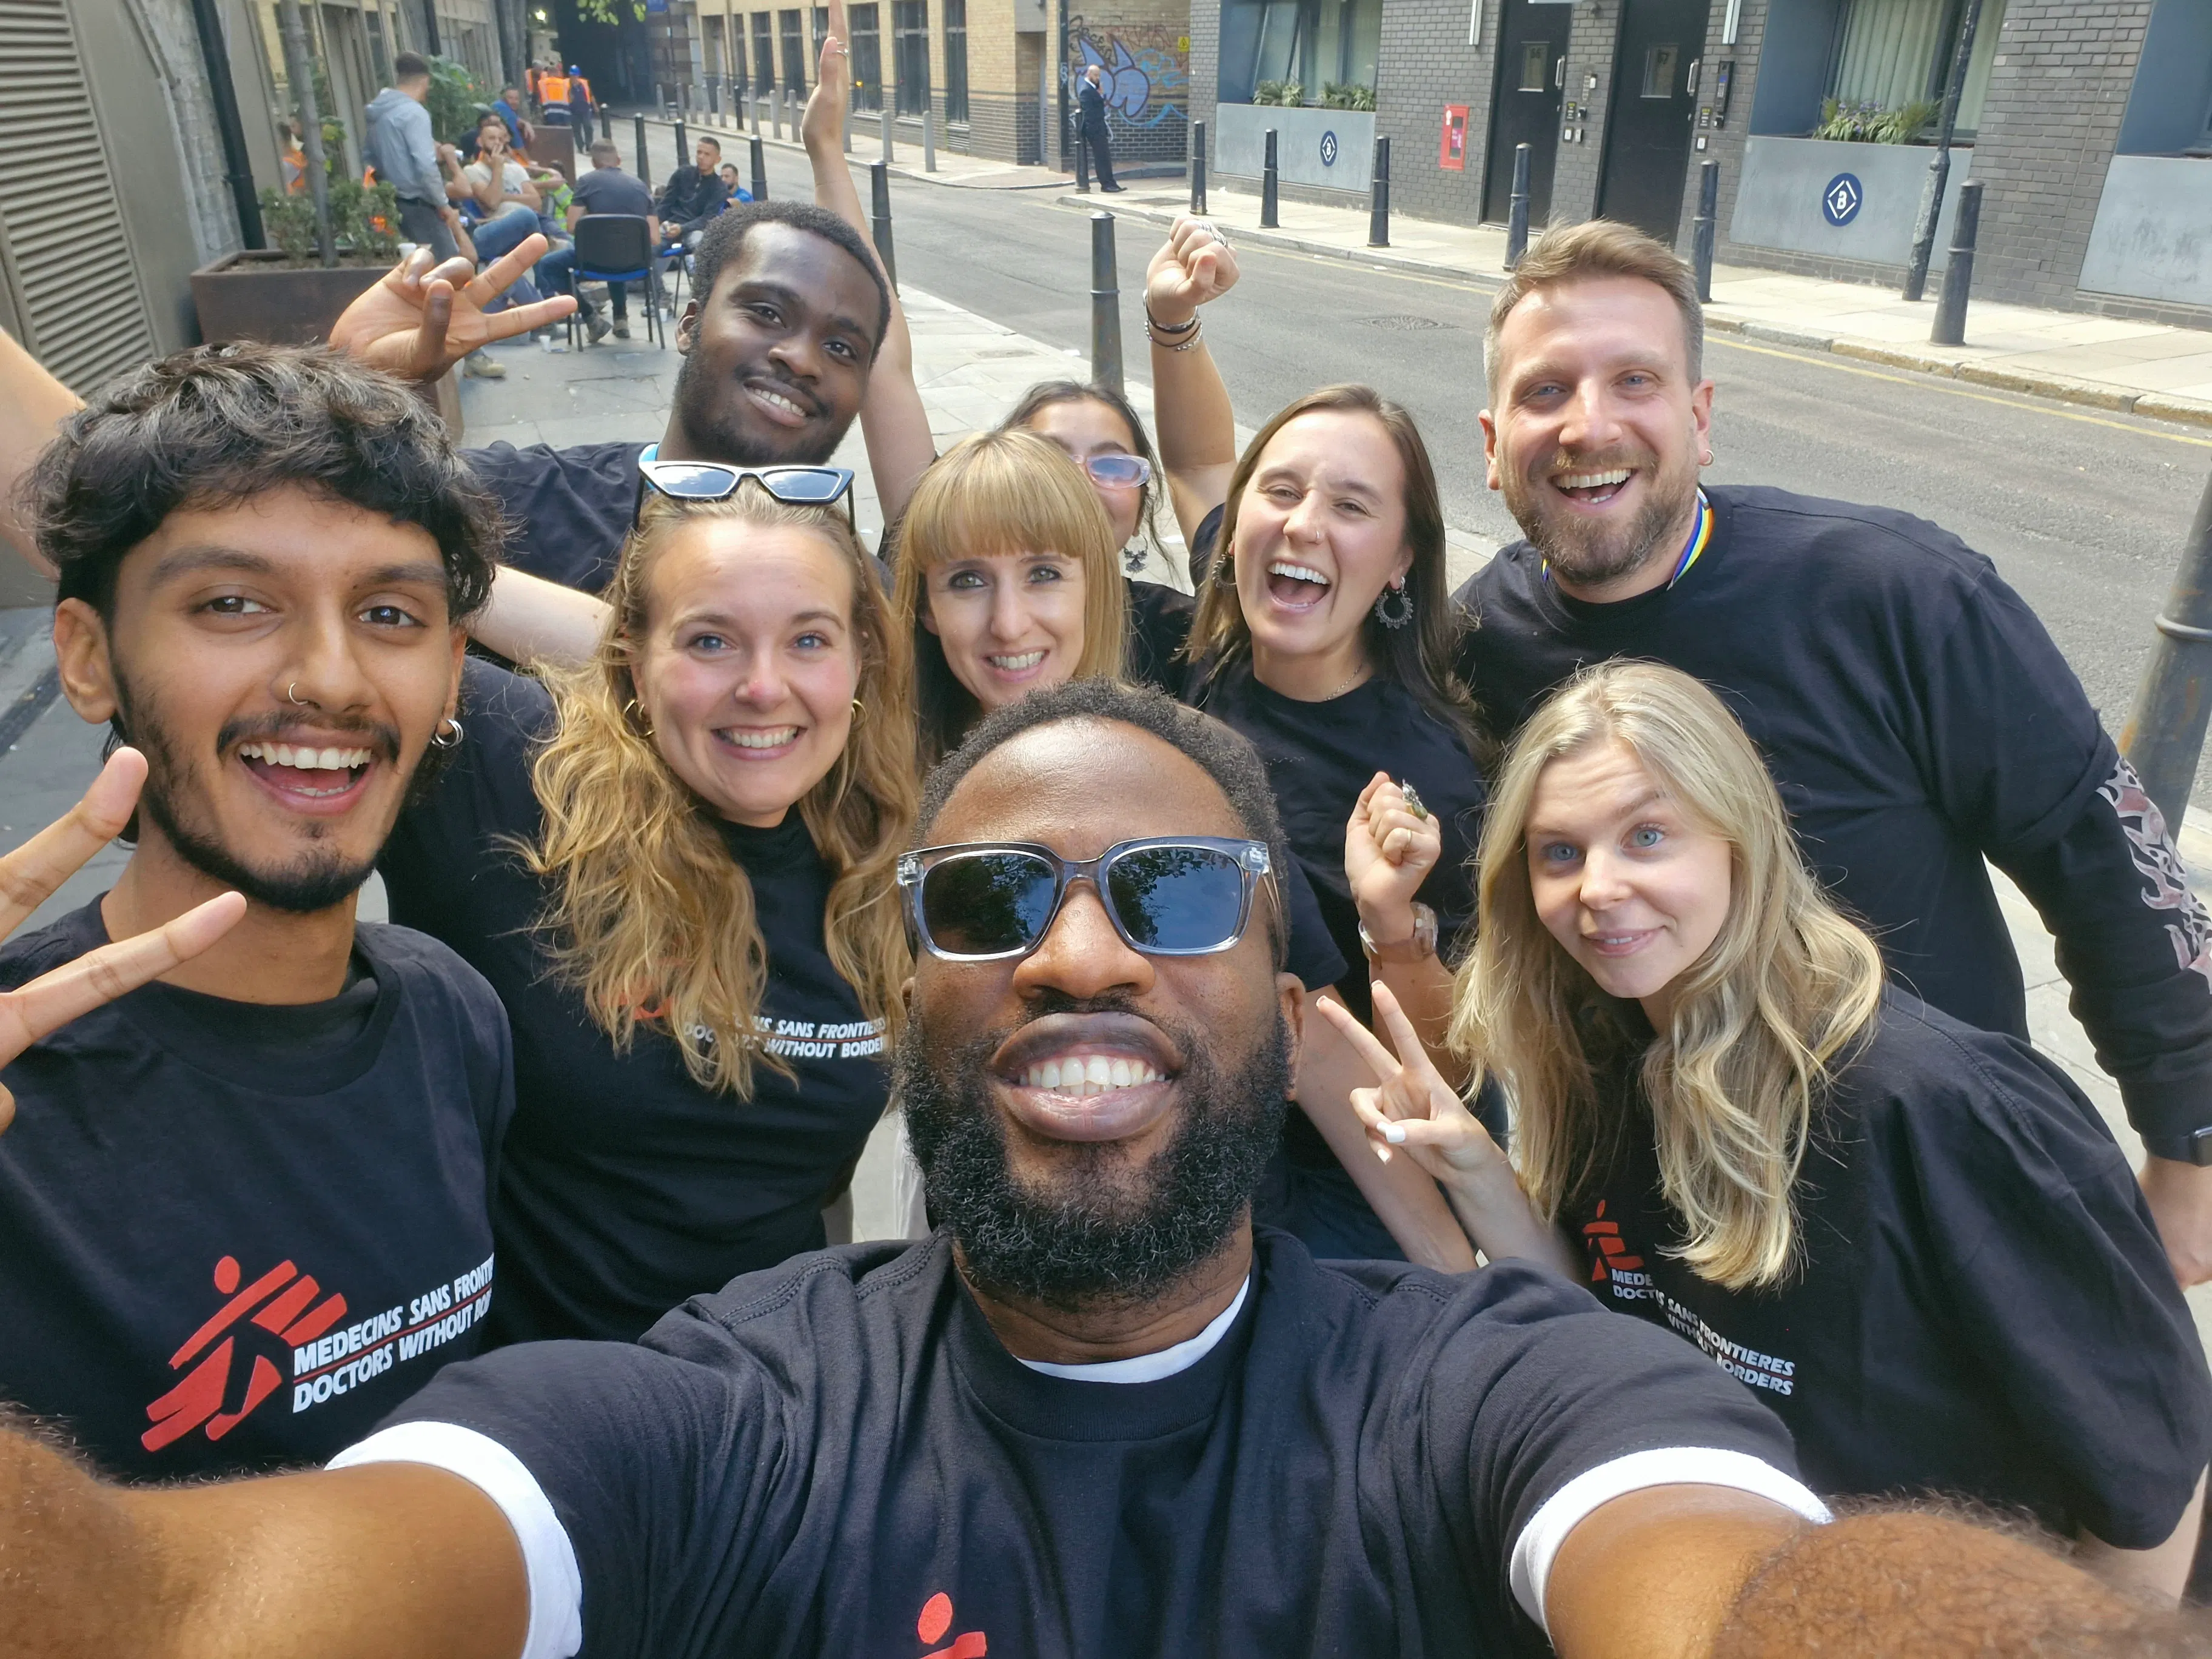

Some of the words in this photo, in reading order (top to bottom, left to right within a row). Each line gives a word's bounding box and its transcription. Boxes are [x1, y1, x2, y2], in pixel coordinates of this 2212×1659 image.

[763, 1037, 837, 1058] WITHOUT
[776, 1019, 816, 1038] SANS
[293, 1342, 393, 1413] DOCTORS
[398, 1303, 473, 1362] WITHOUT
[294, 1305, 403, 1376] MEDECINS
[409, 1284, 451, 1326] SANS
[1667, 1298, 1698, 1327] SANS
[1699, 1319, 1795, 1376] FRONTIERES
